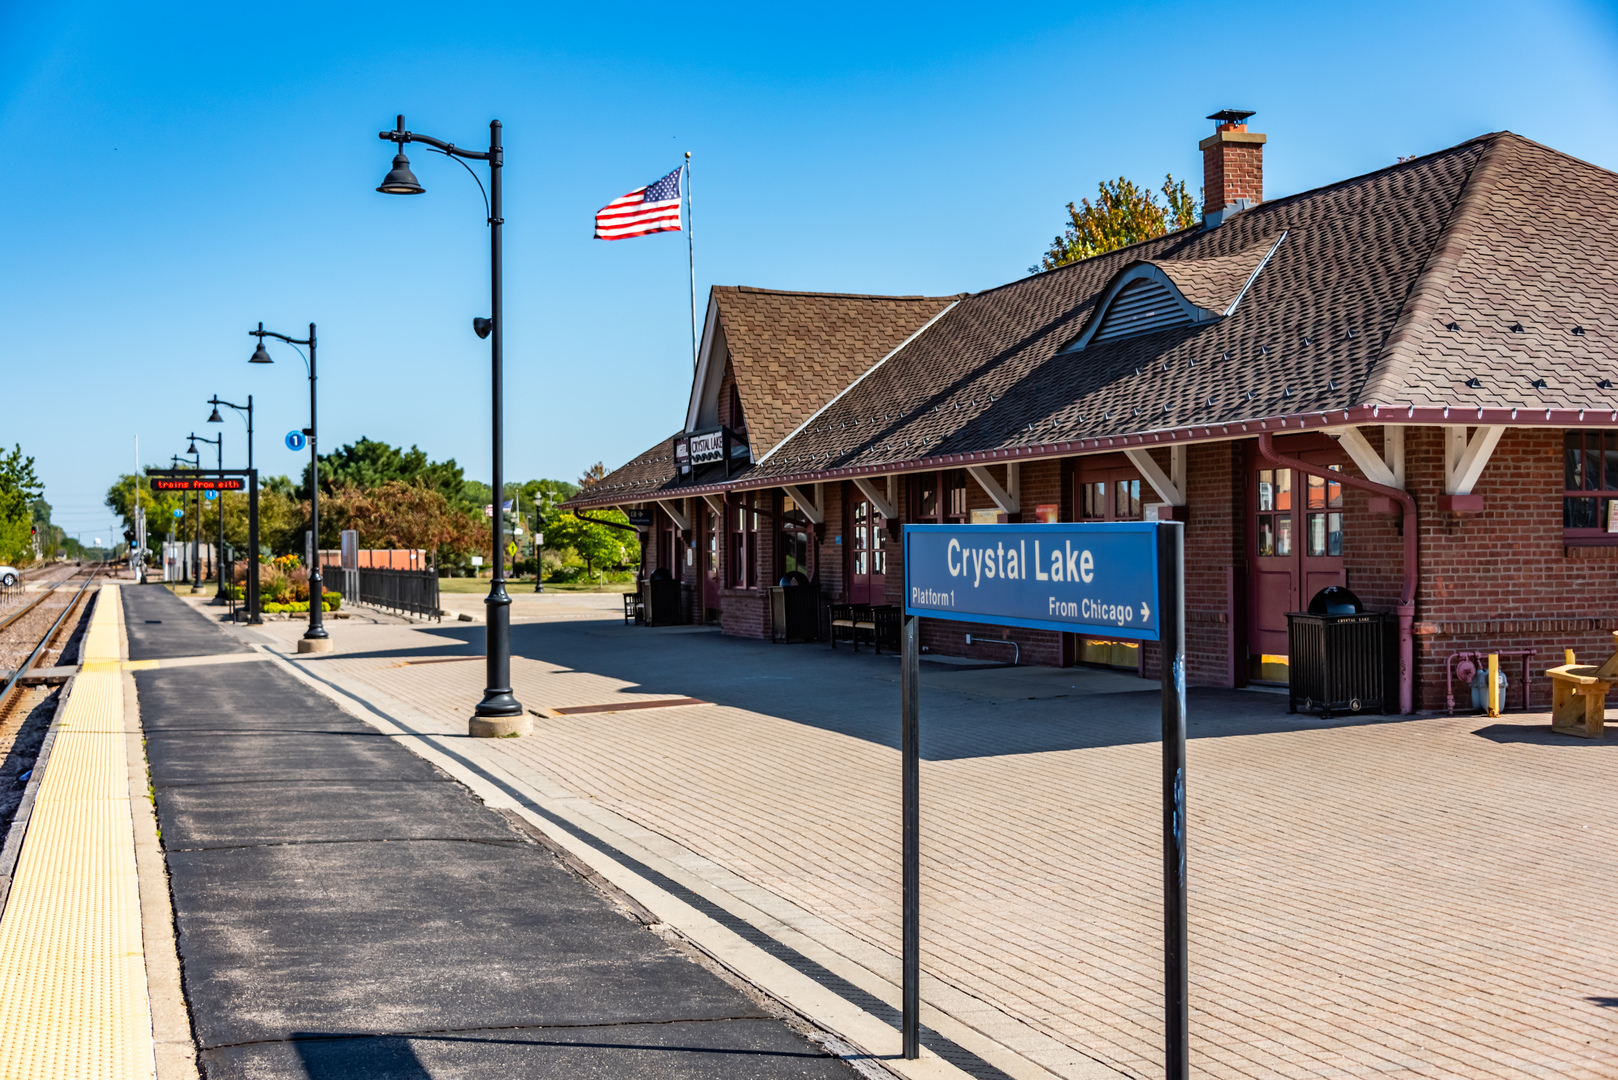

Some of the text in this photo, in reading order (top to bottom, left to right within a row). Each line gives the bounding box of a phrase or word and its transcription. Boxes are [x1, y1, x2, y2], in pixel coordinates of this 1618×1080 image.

[292, 435, 299, 446] 1
[157, 480, 240, 489] trains from eith
[947, 538, 1094, 588] Crystal Lake
[912, 586, 955, 607] Platform 1
[1049, 596, 1133, 626] From Chicago
